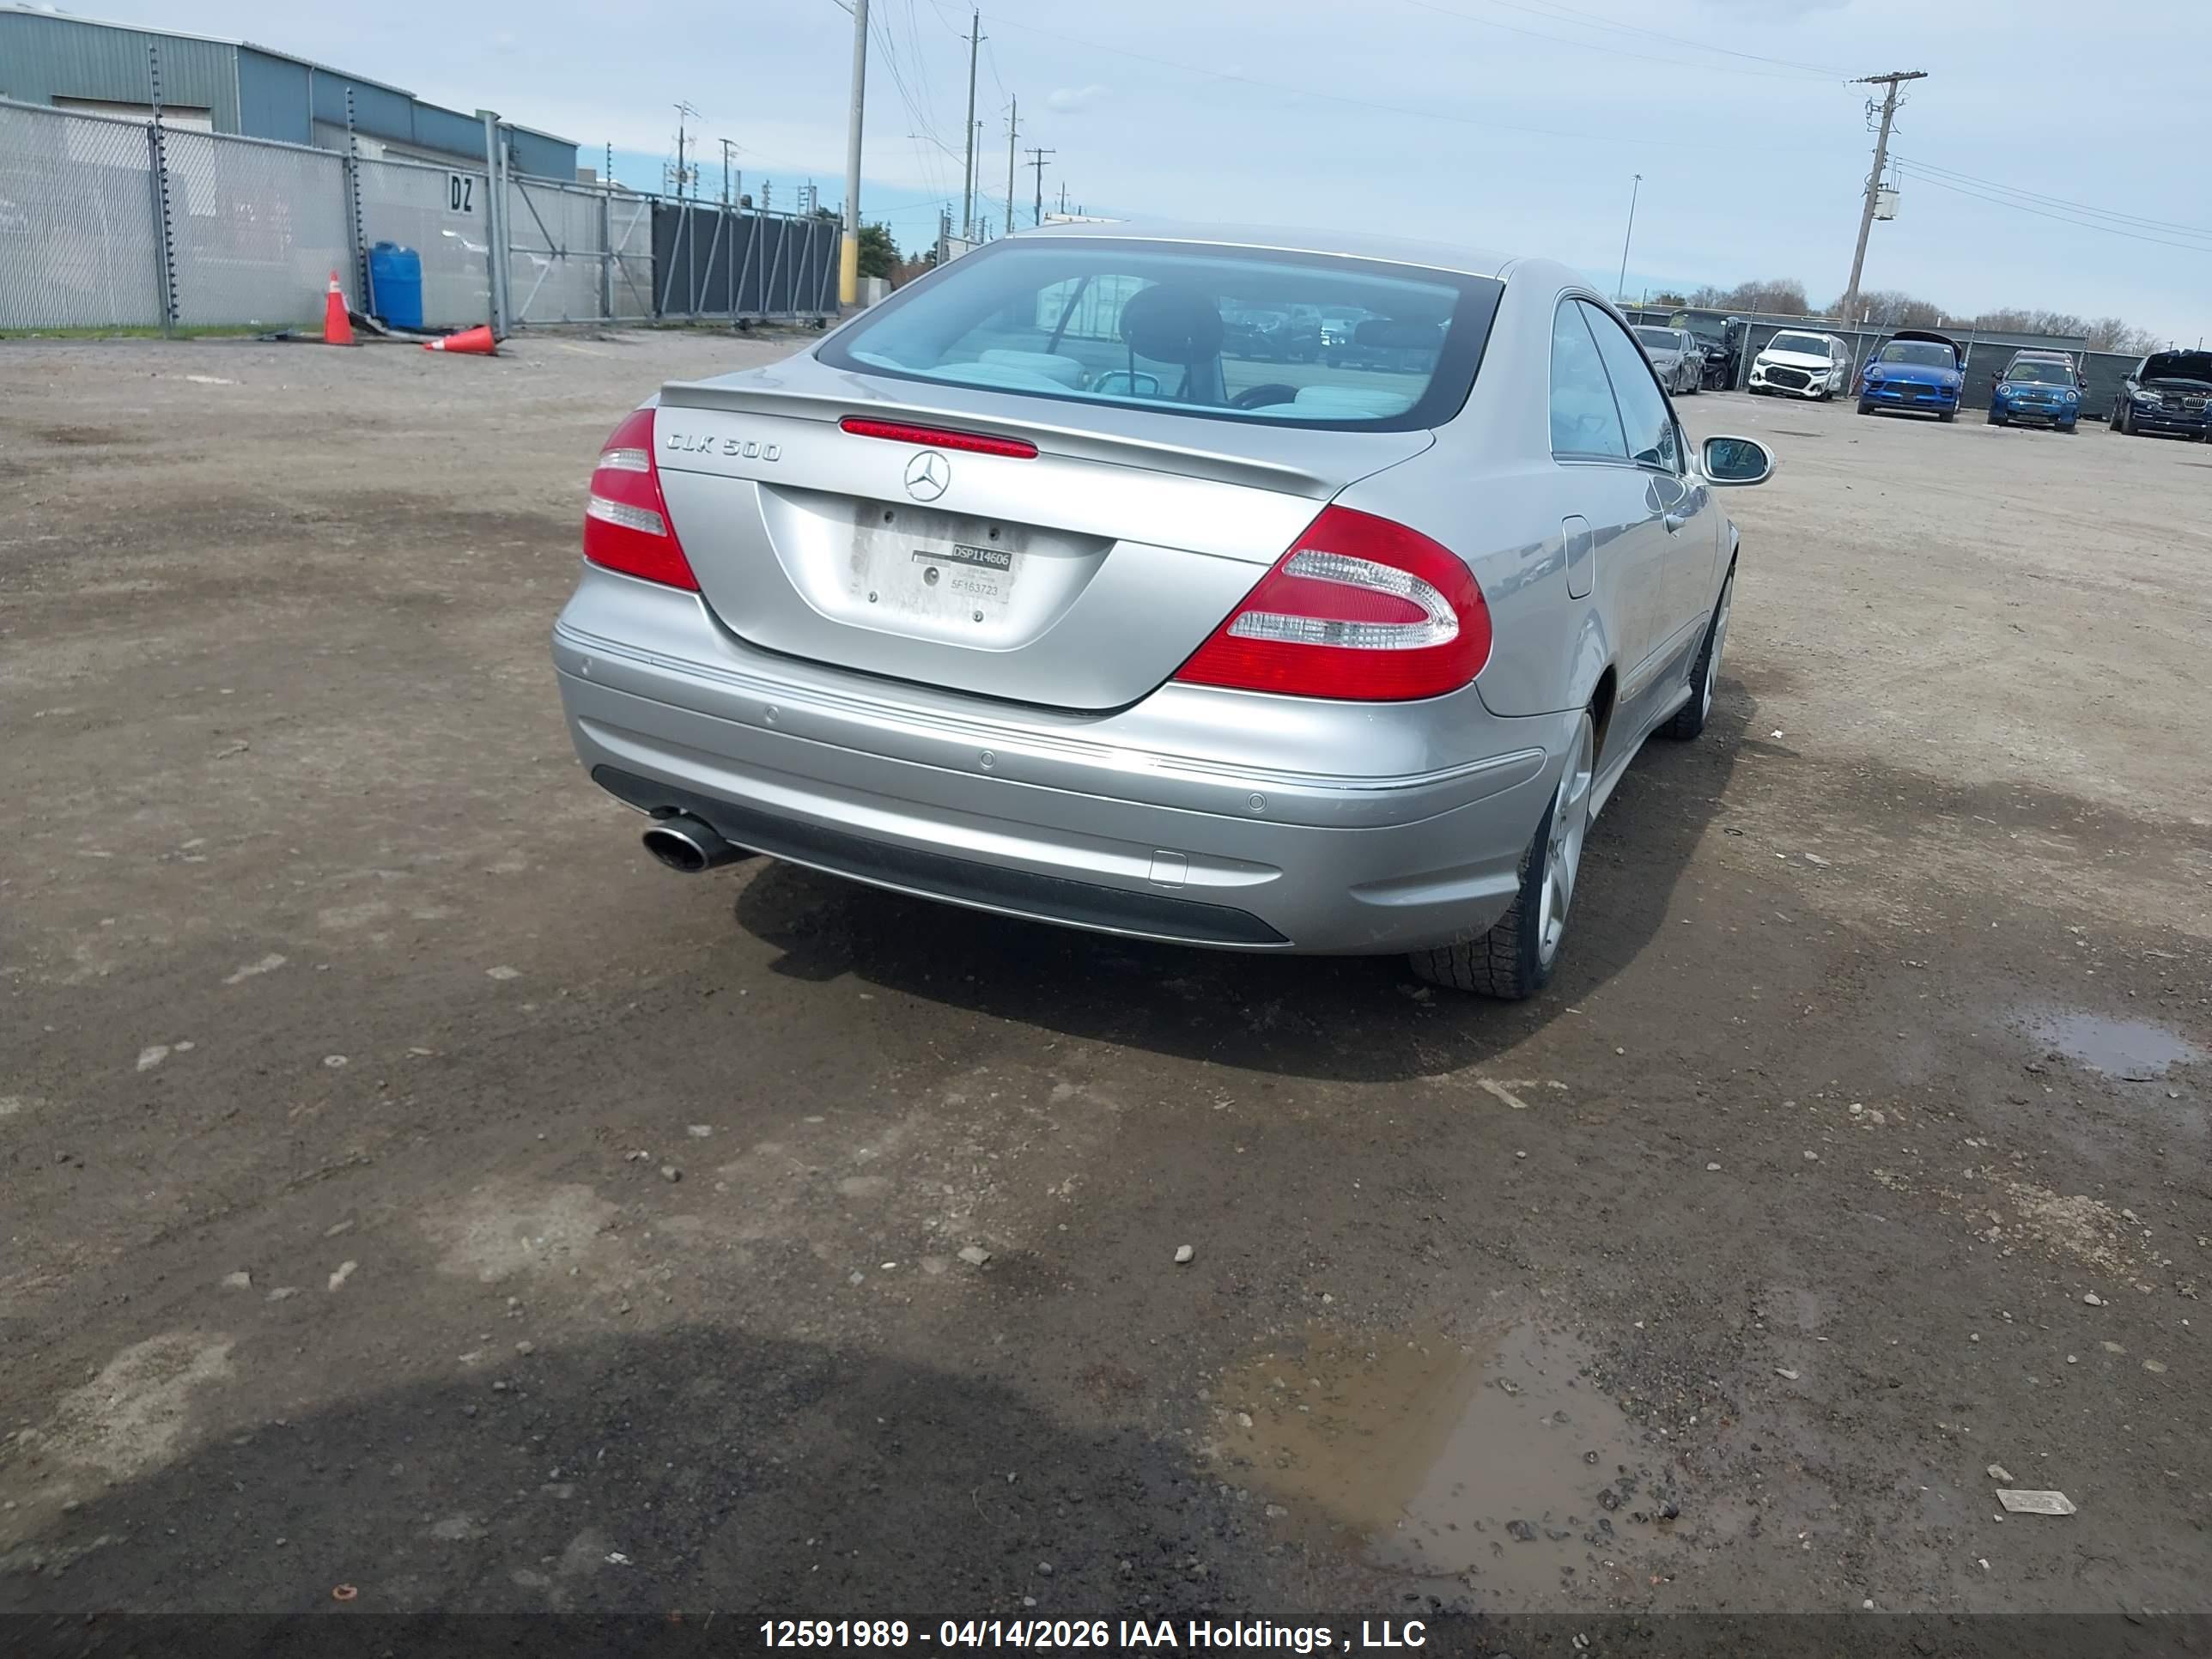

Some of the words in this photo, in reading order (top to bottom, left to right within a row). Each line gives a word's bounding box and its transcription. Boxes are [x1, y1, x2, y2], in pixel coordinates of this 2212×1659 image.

[452, 175, 472, 212] DZ
[666, 434, 714, 454] CLK
[722, 438, 782, 462] 500
[953, 546, 1009, 566] DSP114606
